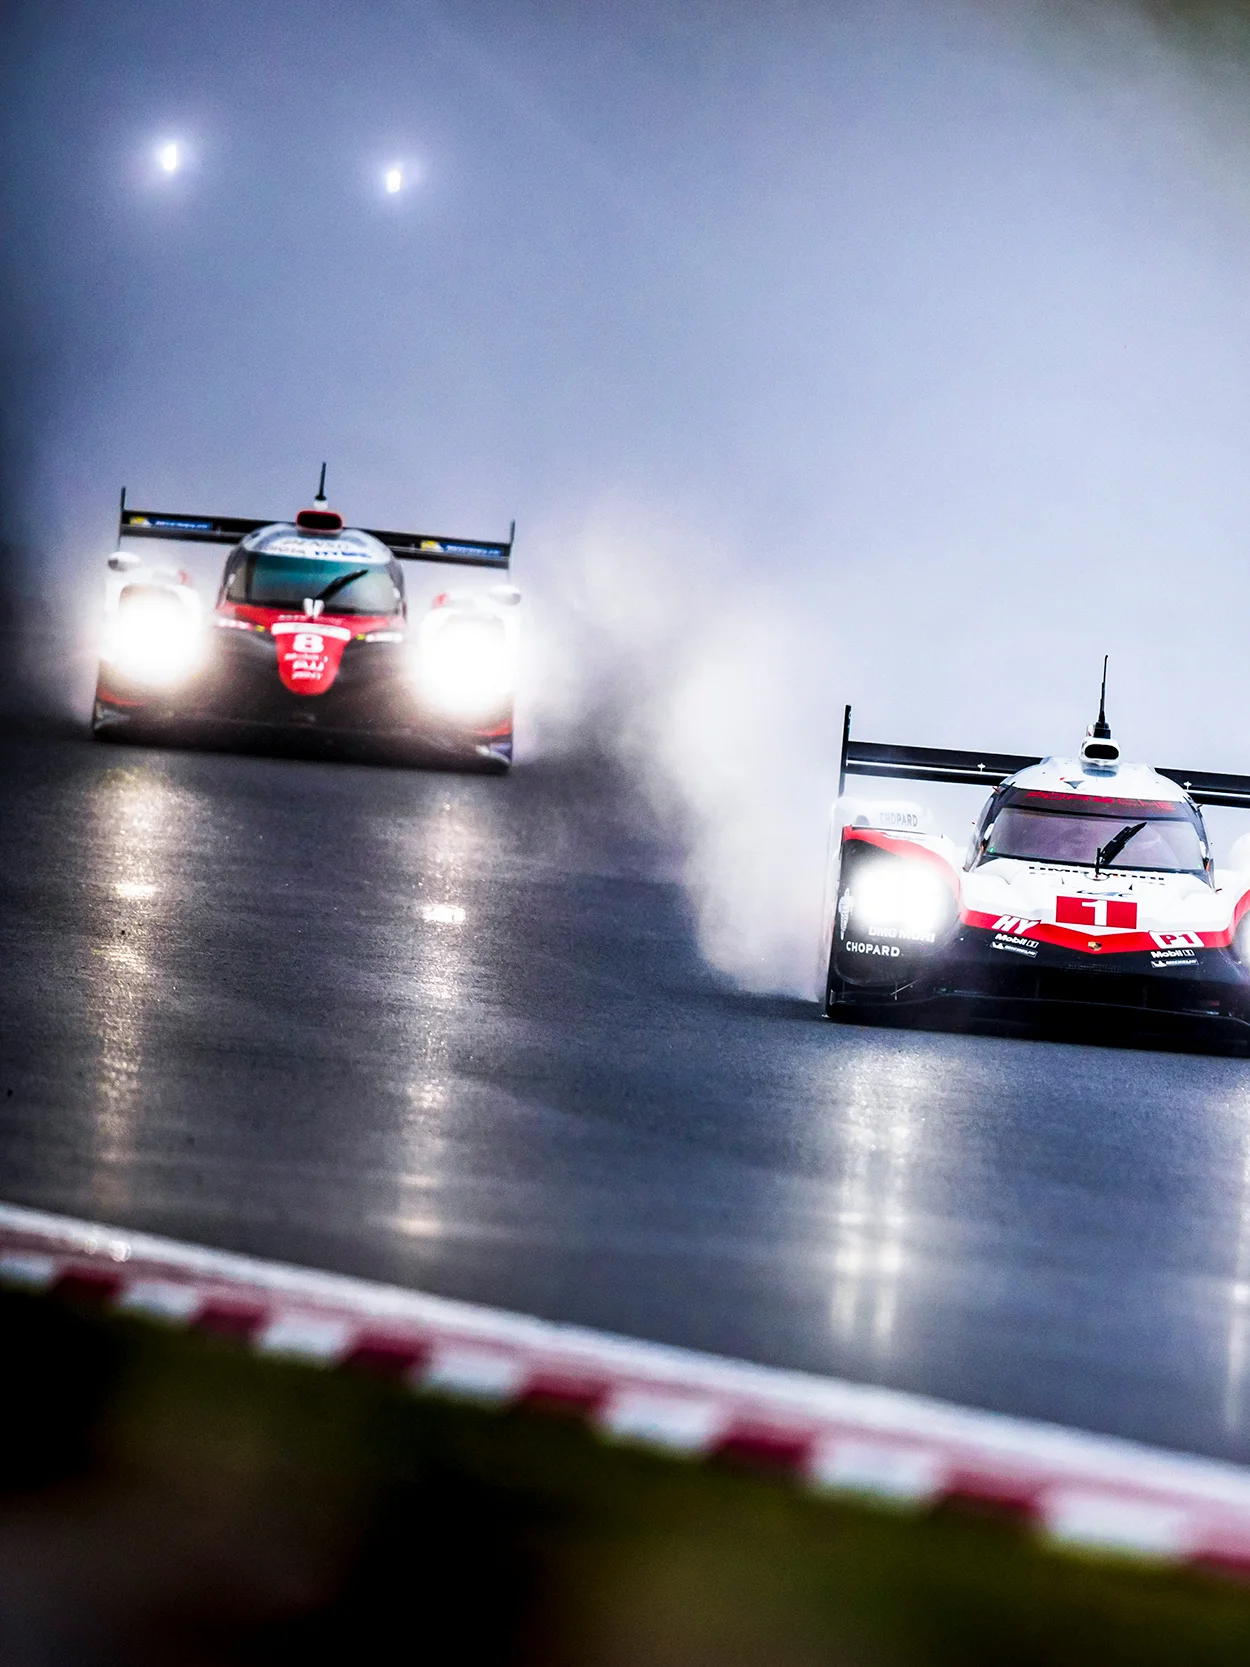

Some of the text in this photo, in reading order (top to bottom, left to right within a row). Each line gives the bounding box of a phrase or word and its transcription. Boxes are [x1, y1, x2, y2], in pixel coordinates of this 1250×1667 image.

[293, 633, 324, 653] 8
[1025, 791, 1176, 811] PORSCHE
[880, 812, 918, 827] CHOPARD
[1081, 900, 1107, 926] 1
[868, 926, 898, 938] DMG
[991, 914, 1040, 935] HY
[994, 933, 1028, 946] Mobil
[1159, 934, 1195, 945] P1
[846, 941, 900, 957] CHOPARD
[1150, 950, 1183, 958] Mobil
